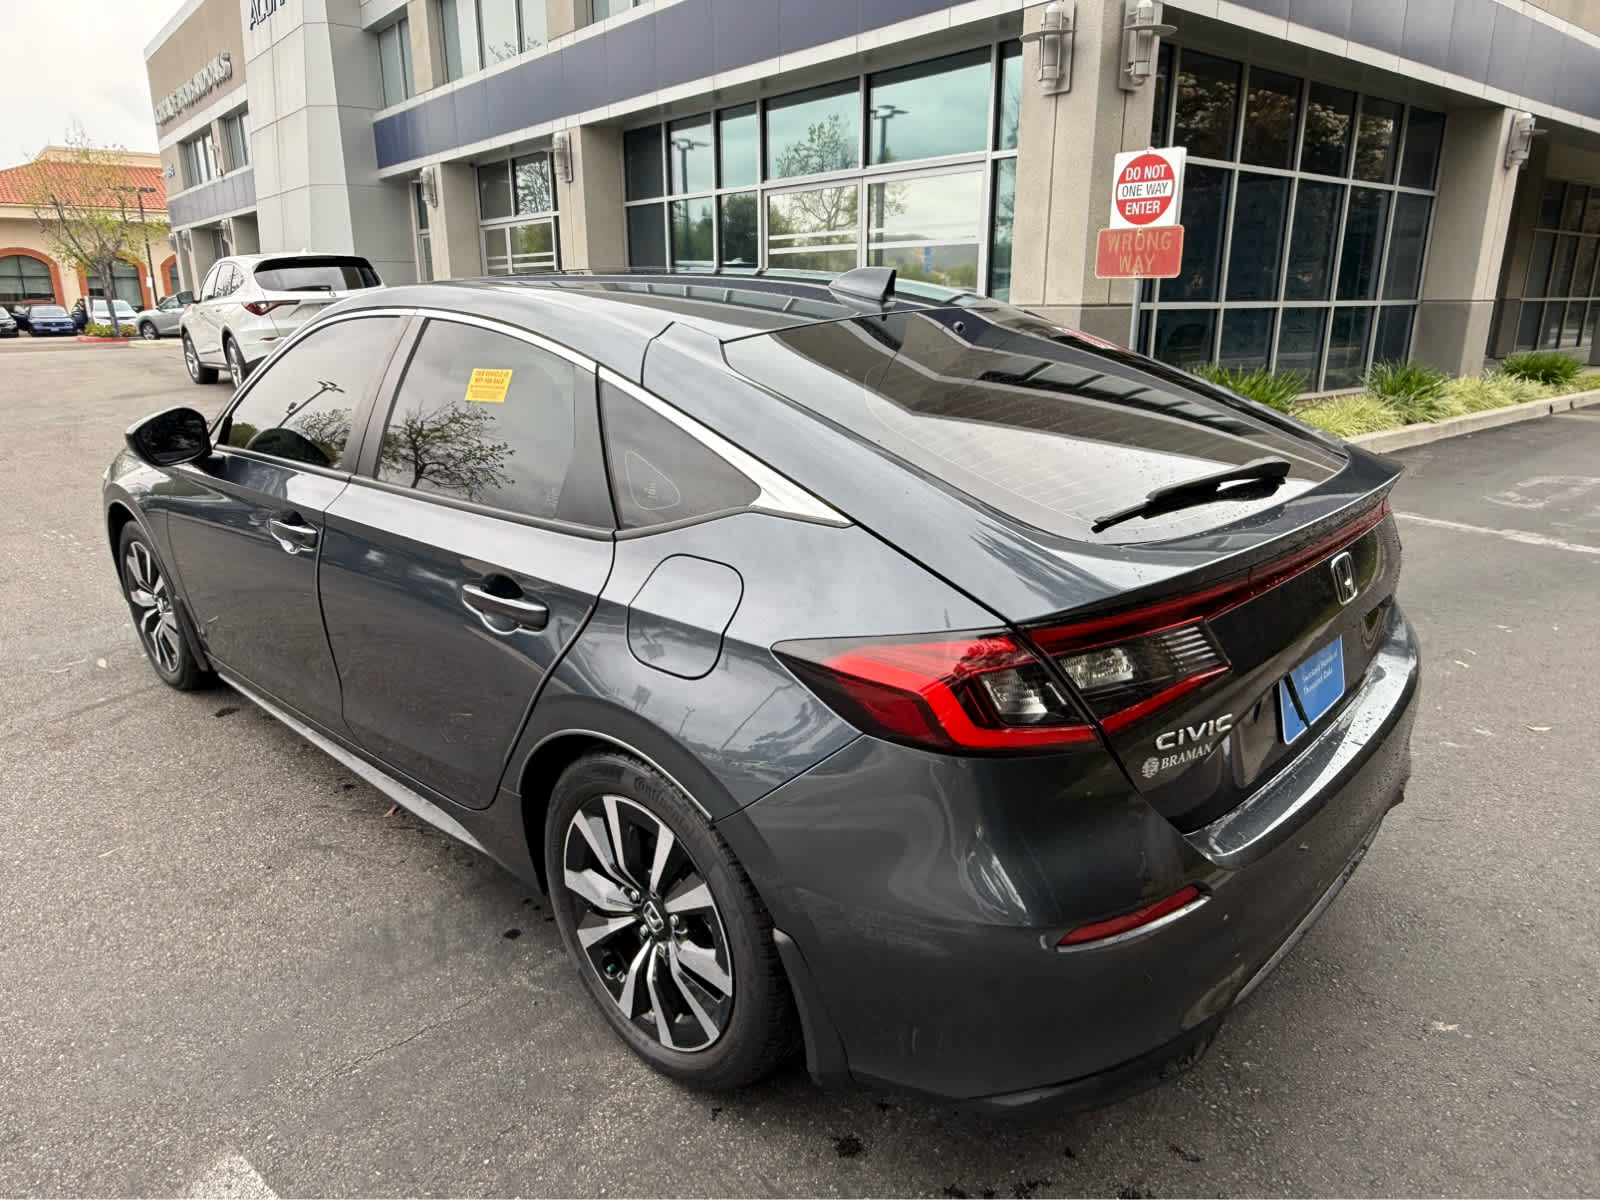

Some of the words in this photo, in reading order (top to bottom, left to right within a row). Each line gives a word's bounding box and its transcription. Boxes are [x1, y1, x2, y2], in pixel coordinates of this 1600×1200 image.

[1125, 167, 1141, 181] DO
[1144, 164, 1168, 179] NOT
[1121, 184, 1142, 198] ONE
[1146, 182, 1169, 195] WAY
[1125, 200, 1161, 216] ENTER
[1107, 231, 1172, 254] WRONG
[1119, 255, 1155, 274] WAY
[1156, 713, 1233, 750] CIVIC
[1160, 741, 1214, 770] BRAMAN
